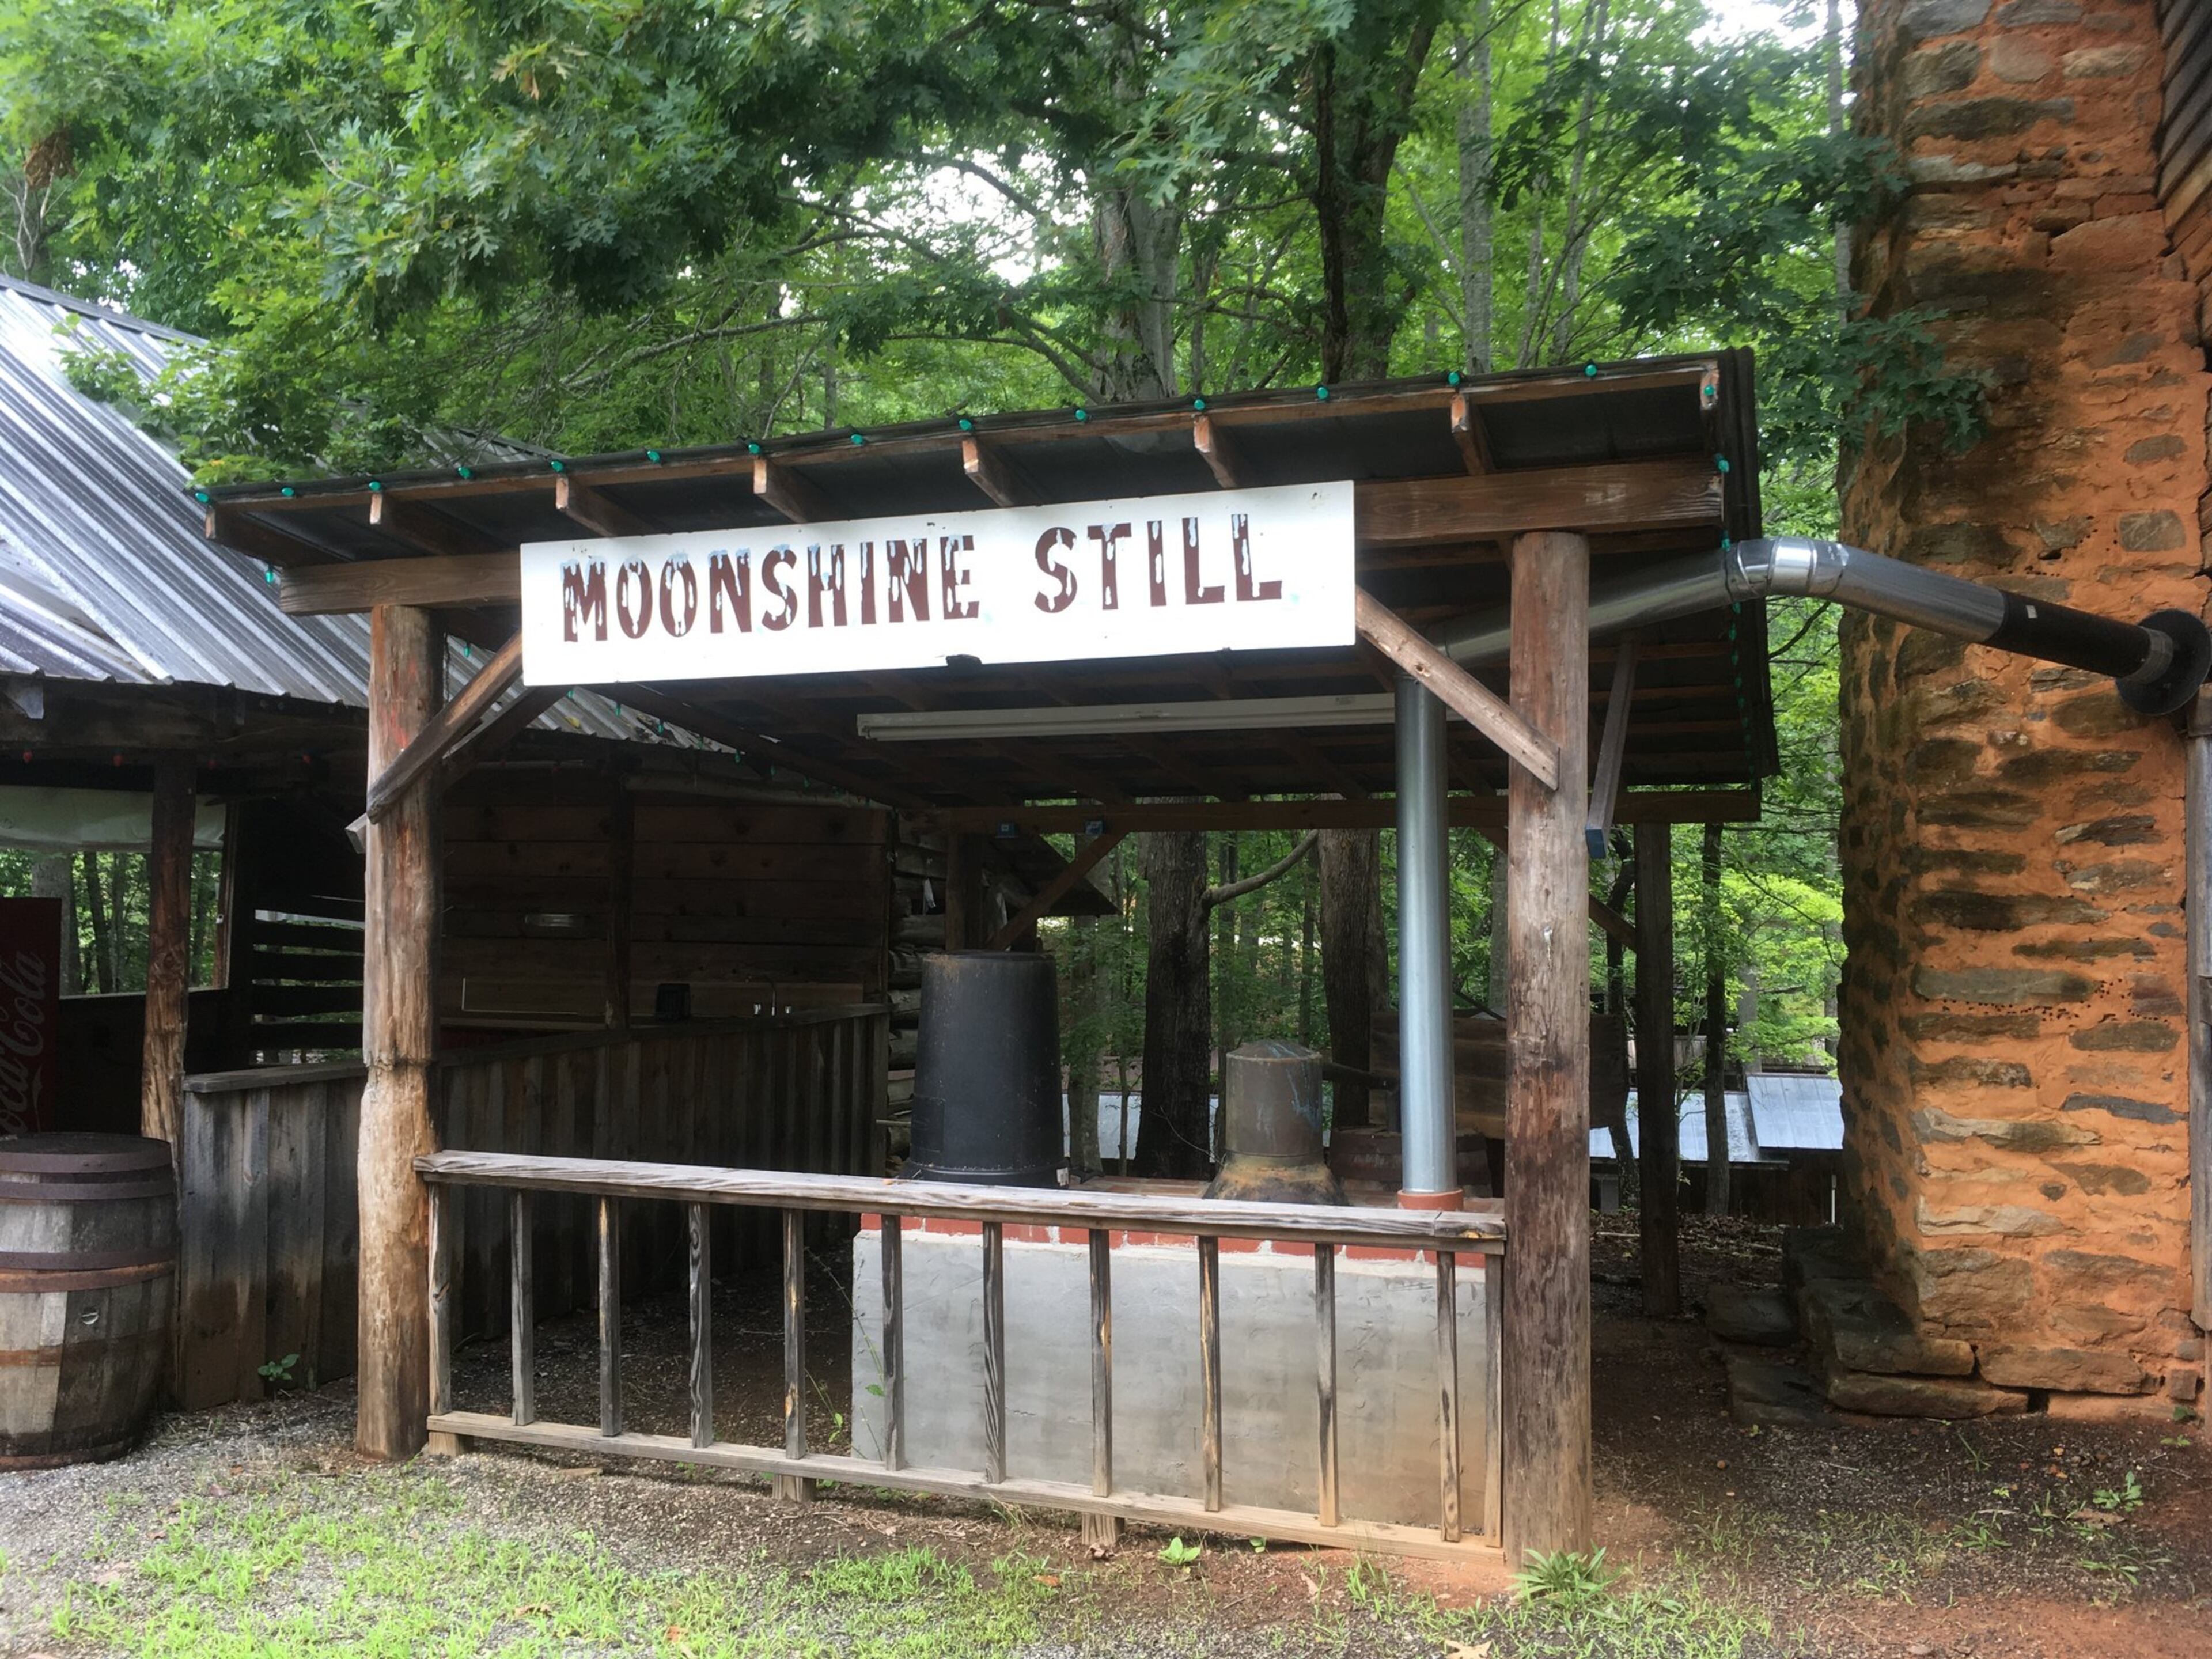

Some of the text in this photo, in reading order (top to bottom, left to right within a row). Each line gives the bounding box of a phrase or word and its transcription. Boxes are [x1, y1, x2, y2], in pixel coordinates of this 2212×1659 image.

[561, 513, 1282, 642] MOONSHINE STILL
[0, 950, 46, 1133] oca-Cola
